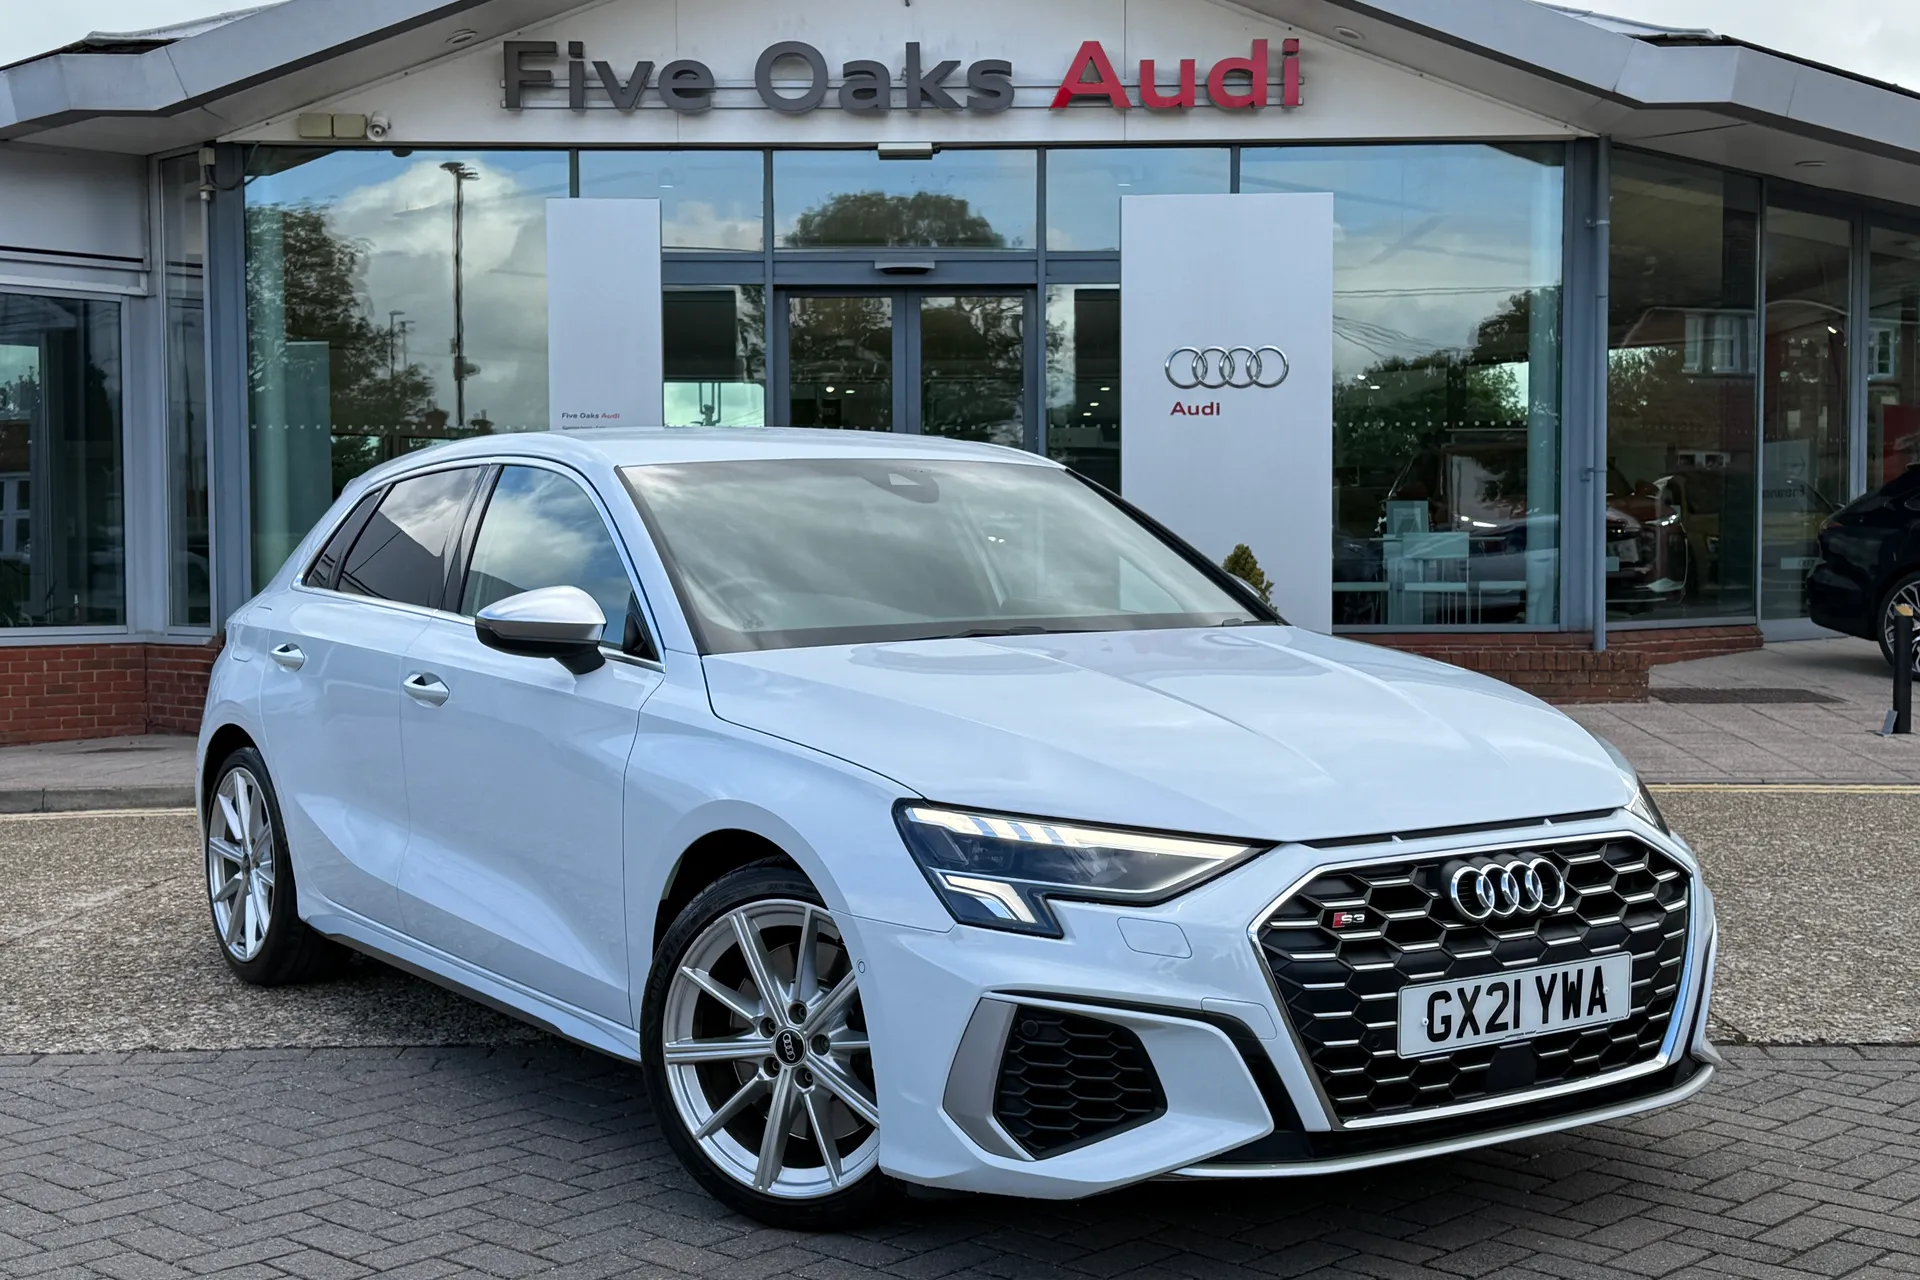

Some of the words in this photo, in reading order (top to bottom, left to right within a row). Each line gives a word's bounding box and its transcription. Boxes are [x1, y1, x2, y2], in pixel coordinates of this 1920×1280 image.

[503, 41, 716, 114] Five
[755, 41, 1015, 113] Oaks
[1050, 39, 1300, 110] Audi
[1170, 401, 1221, 416] Audi
[1341, 914, 1365, 924] S3
[1427, 979, 1521, 1043] GX21
[1535, 965, 1608, 1025] YWA
